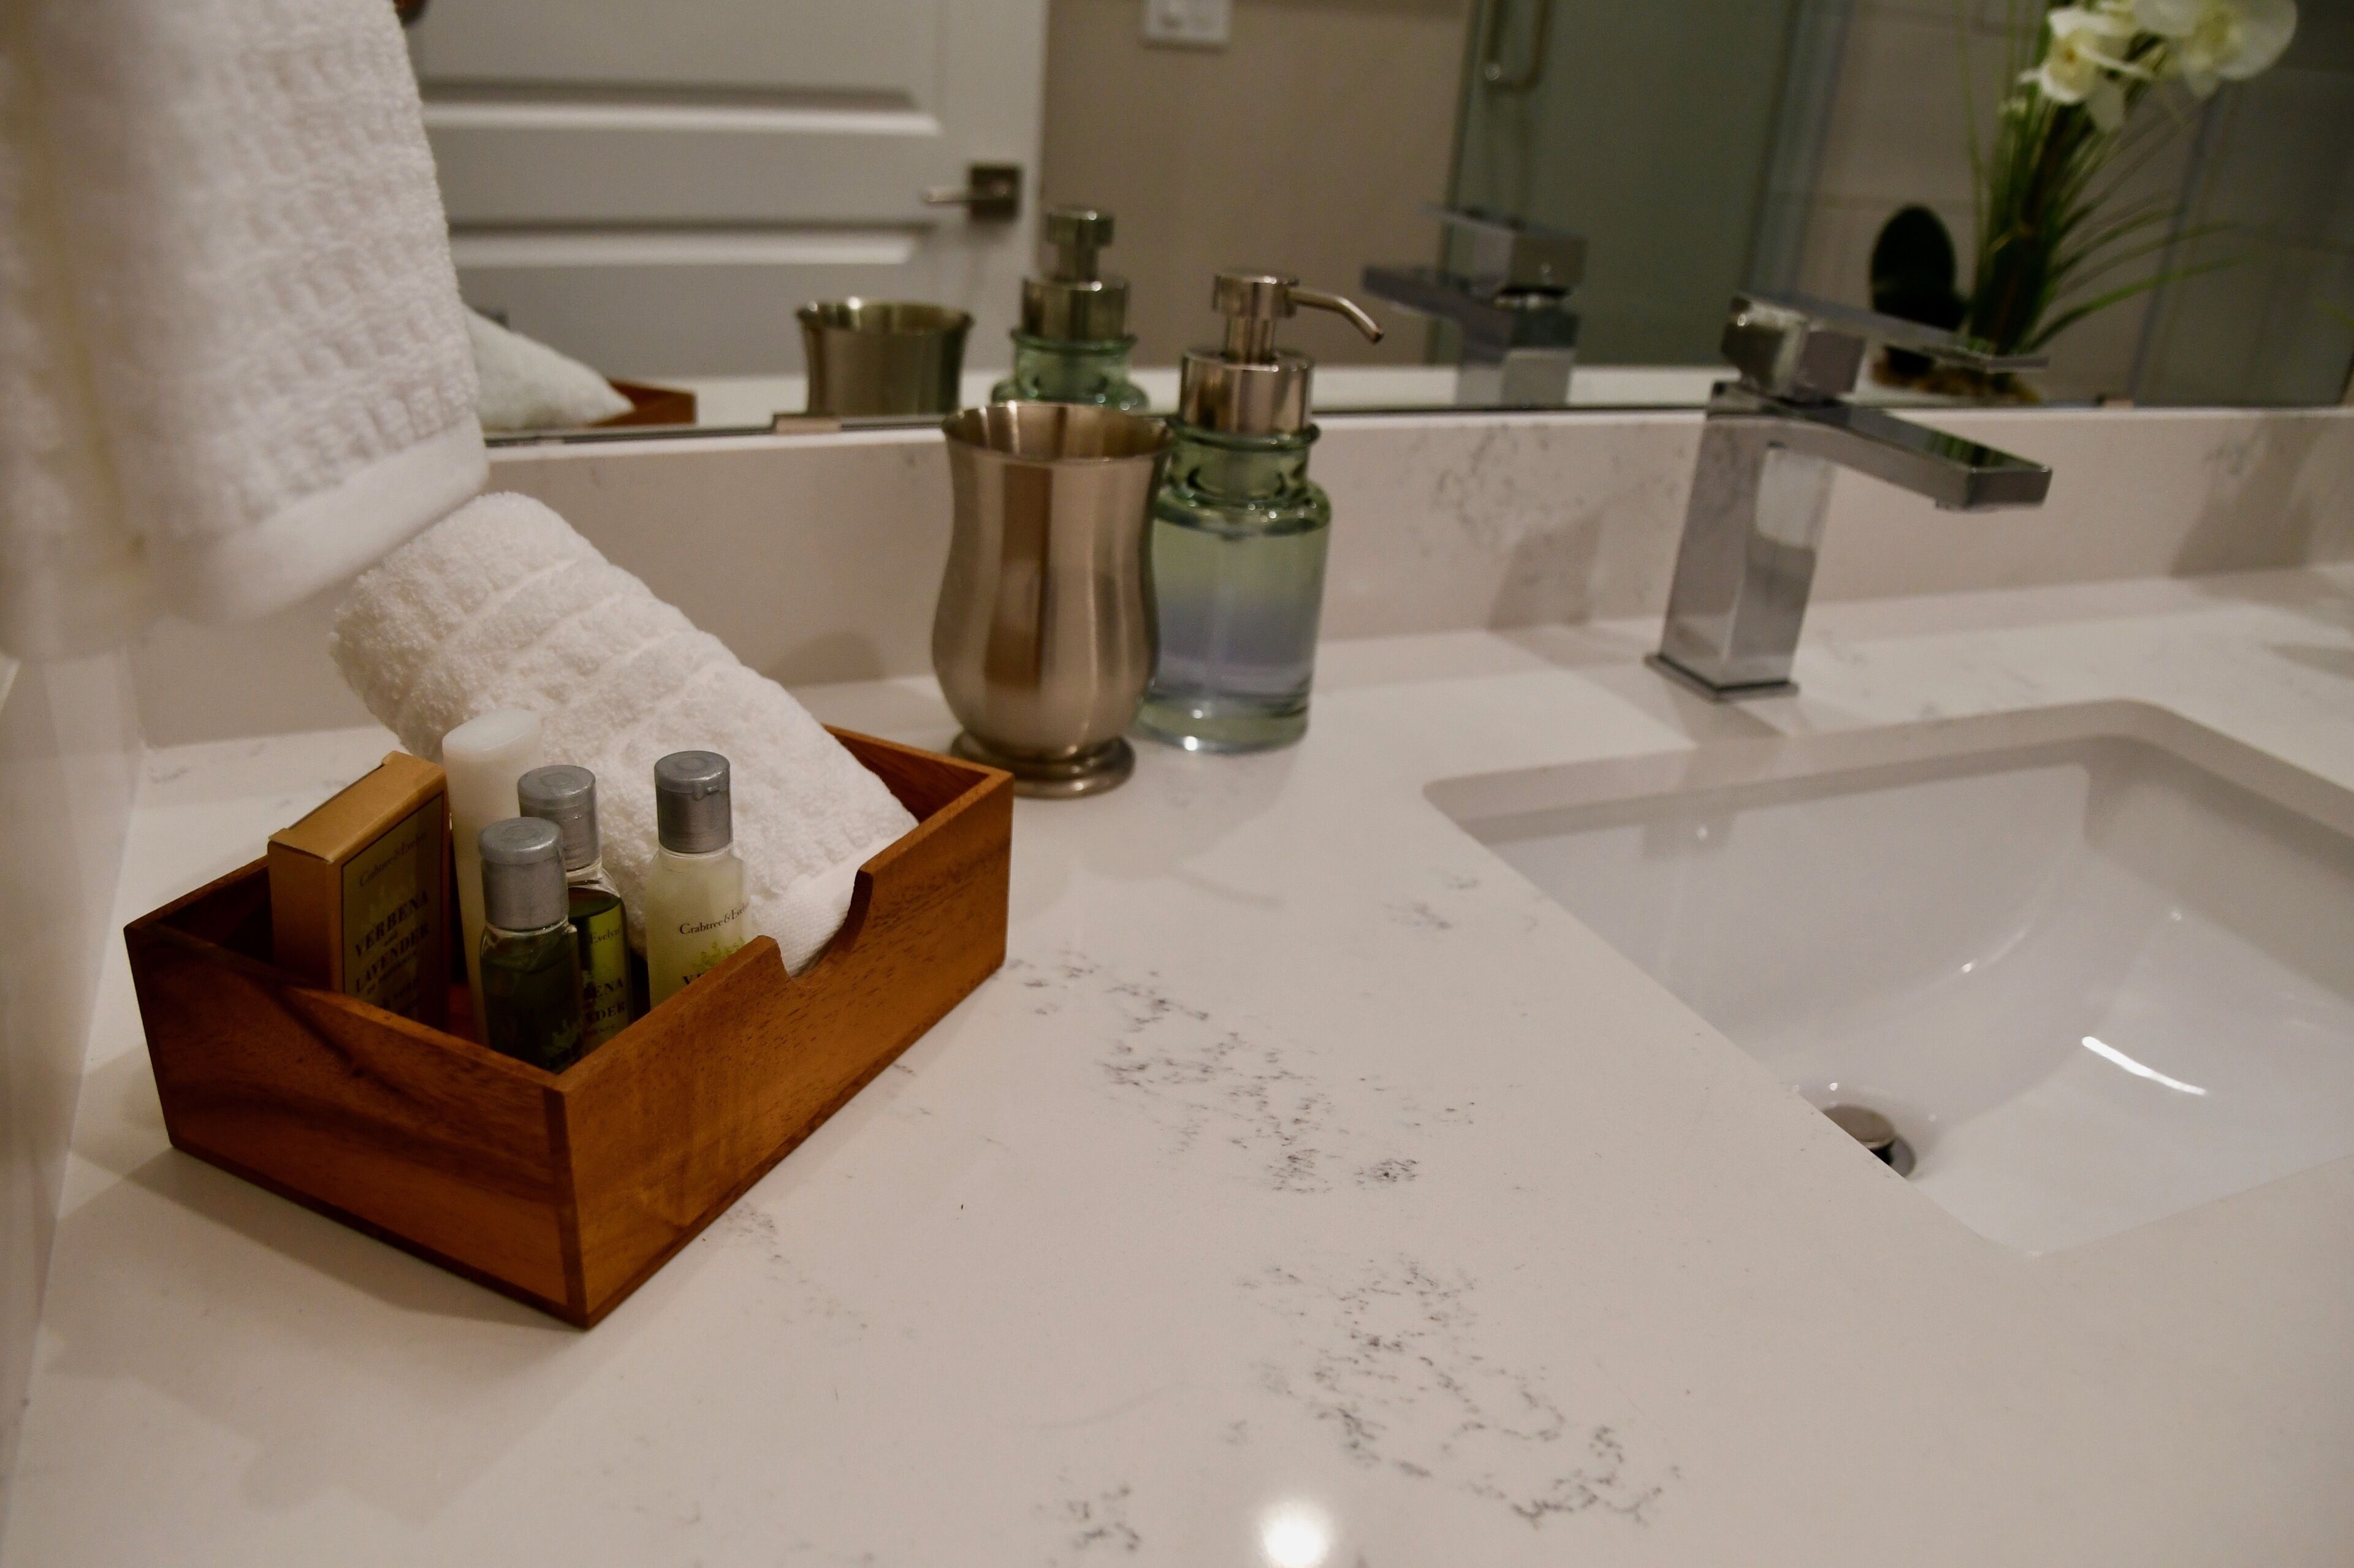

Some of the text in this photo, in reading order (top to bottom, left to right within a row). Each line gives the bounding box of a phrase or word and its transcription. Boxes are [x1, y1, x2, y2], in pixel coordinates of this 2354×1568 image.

[355, 889, 429, 958] VERBENA
[356, 921, 429, 994] LAVENDER
[679, 919, 722, 935] Crabtree
